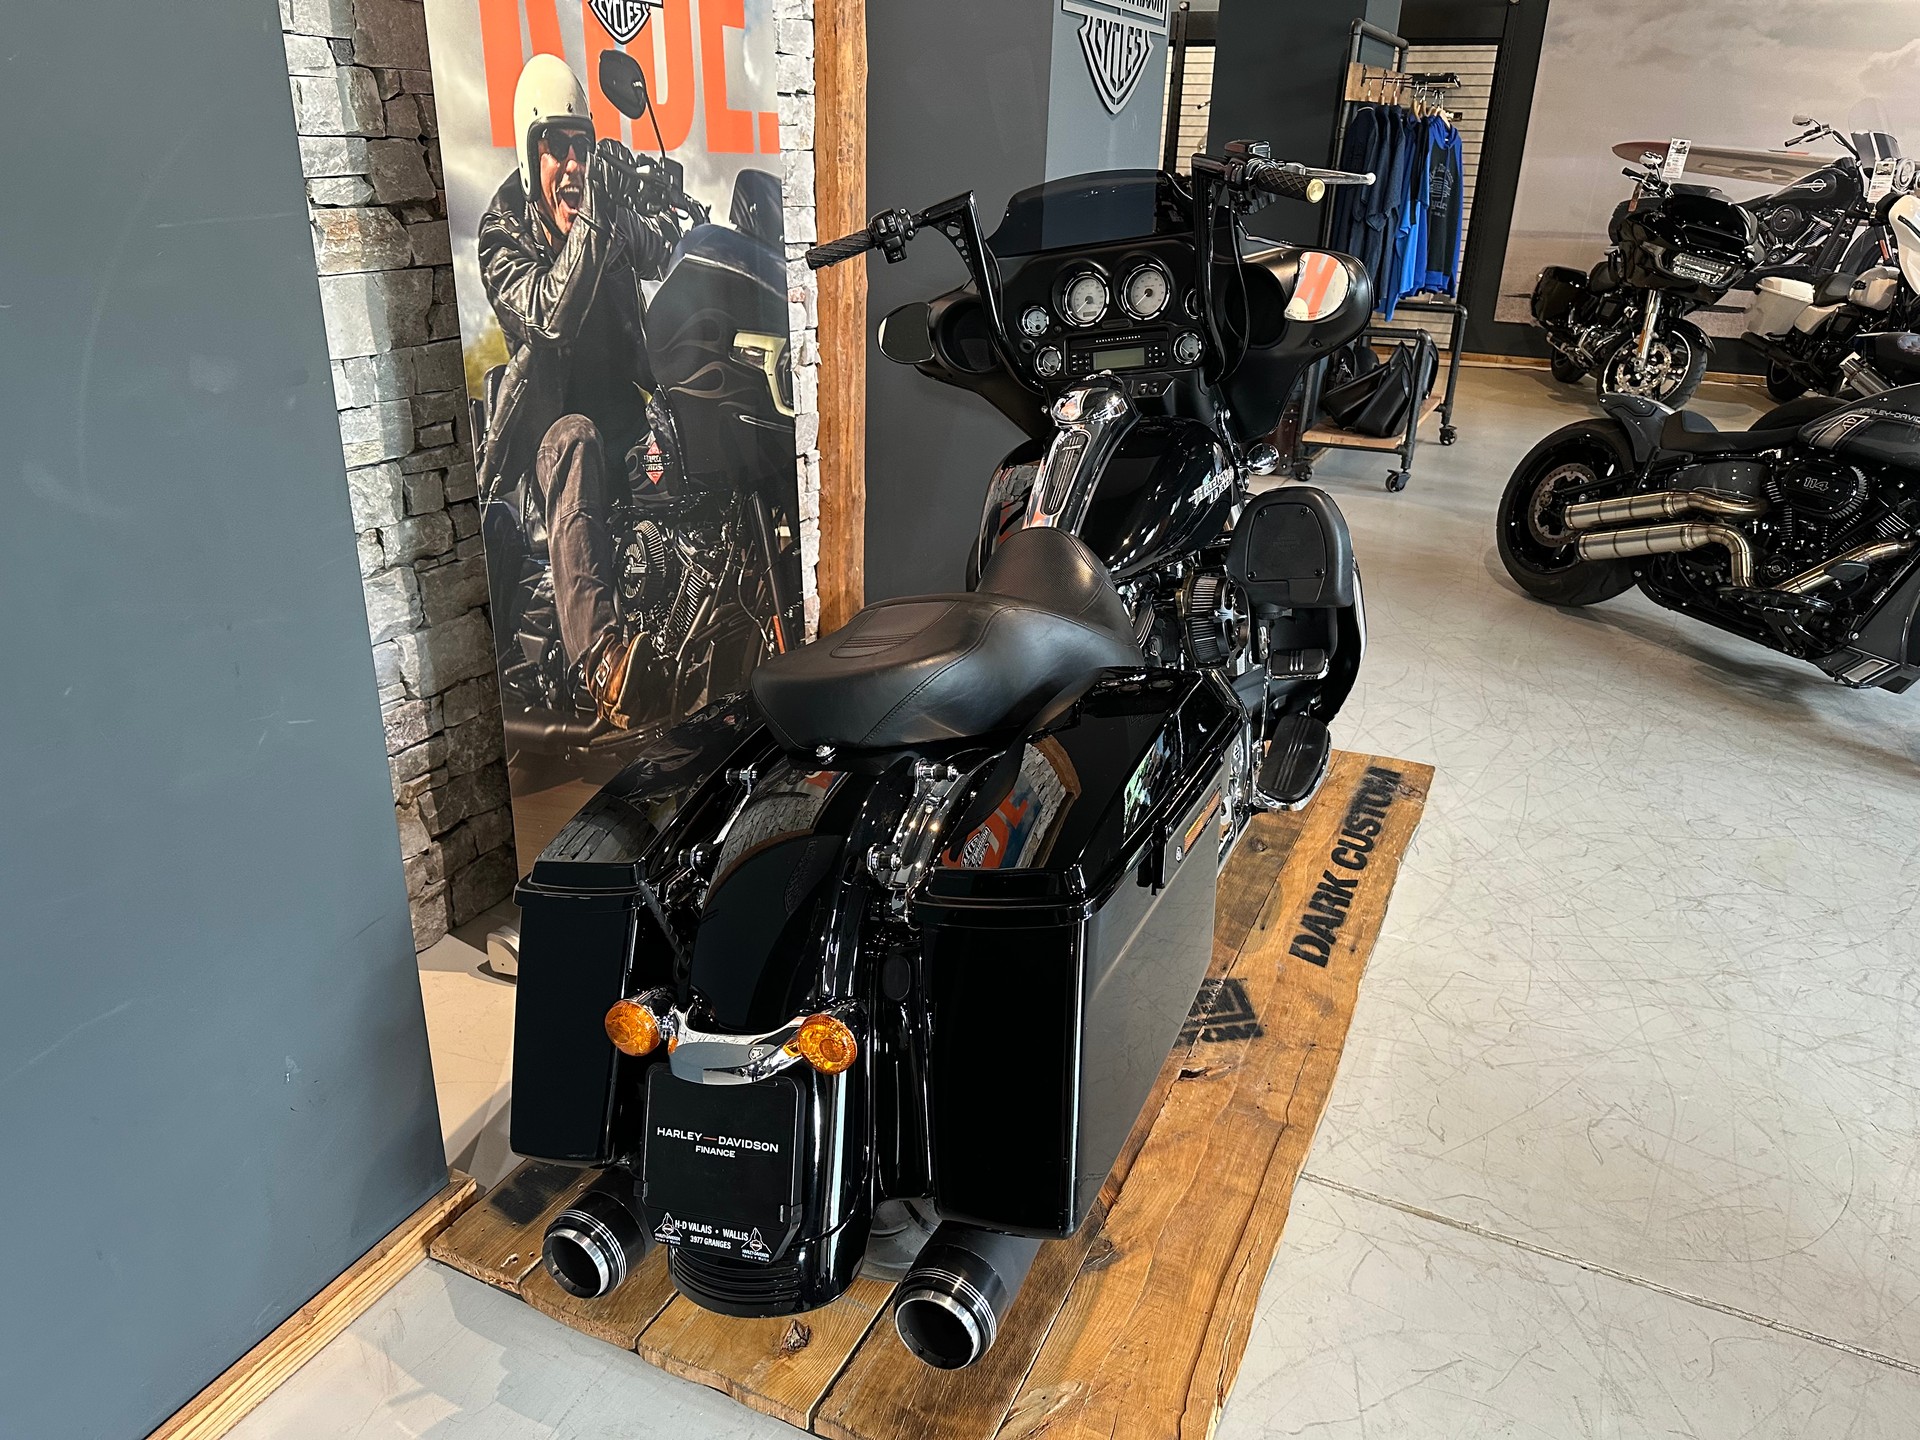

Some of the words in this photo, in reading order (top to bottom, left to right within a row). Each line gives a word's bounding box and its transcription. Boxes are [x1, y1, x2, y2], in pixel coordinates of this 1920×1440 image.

[1094, 18, 1143, 92] CYCLES
[1803, 476, 1829, 491] 114
[1289, 869, 1358, 968] DARK
[1331, 766, 1401, 871] CUSTOM
[695, 1144, 736, 1158] FINANCE
[674, 1219, 687, 1230] H-D
[688, 1221, 712, 1234] VALAIS
[722, 1228, 749, 1241] WALLIS
[690, 1235, 703, 1245] 3977
[703, 1237, 731, 1250] GRANGES
